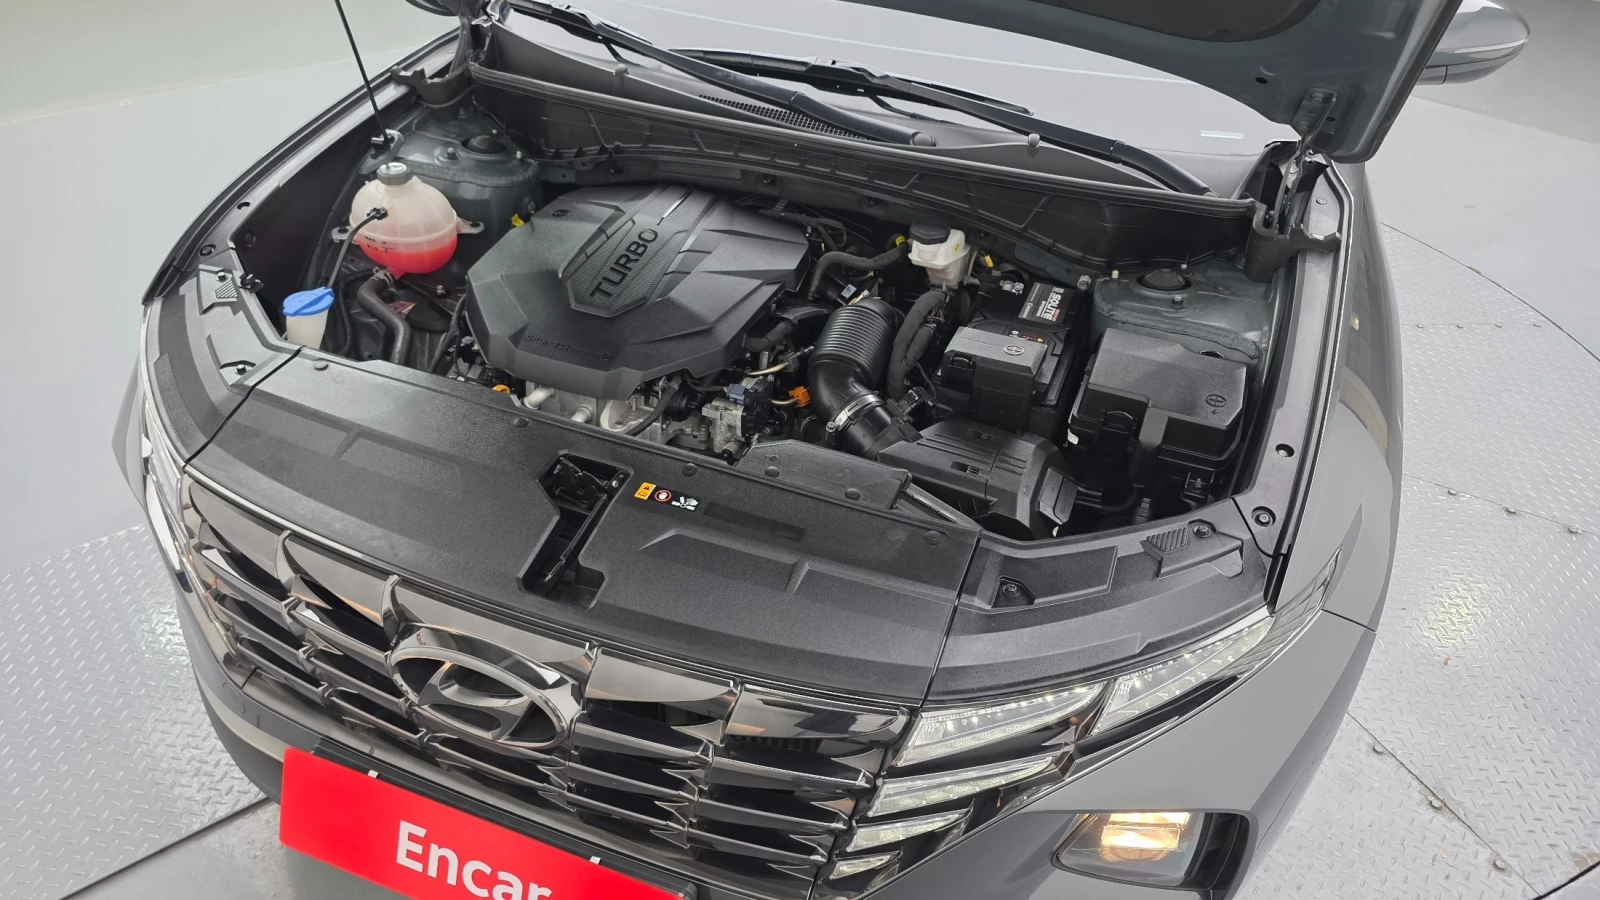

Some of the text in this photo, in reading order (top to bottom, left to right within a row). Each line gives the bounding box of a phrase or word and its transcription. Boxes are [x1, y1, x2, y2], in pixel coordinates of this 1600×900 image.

[590, 229, 659, 297] TURBO
[527, 335, 601, 359] Smartstream
[396, 820, 552, 900] Encar
